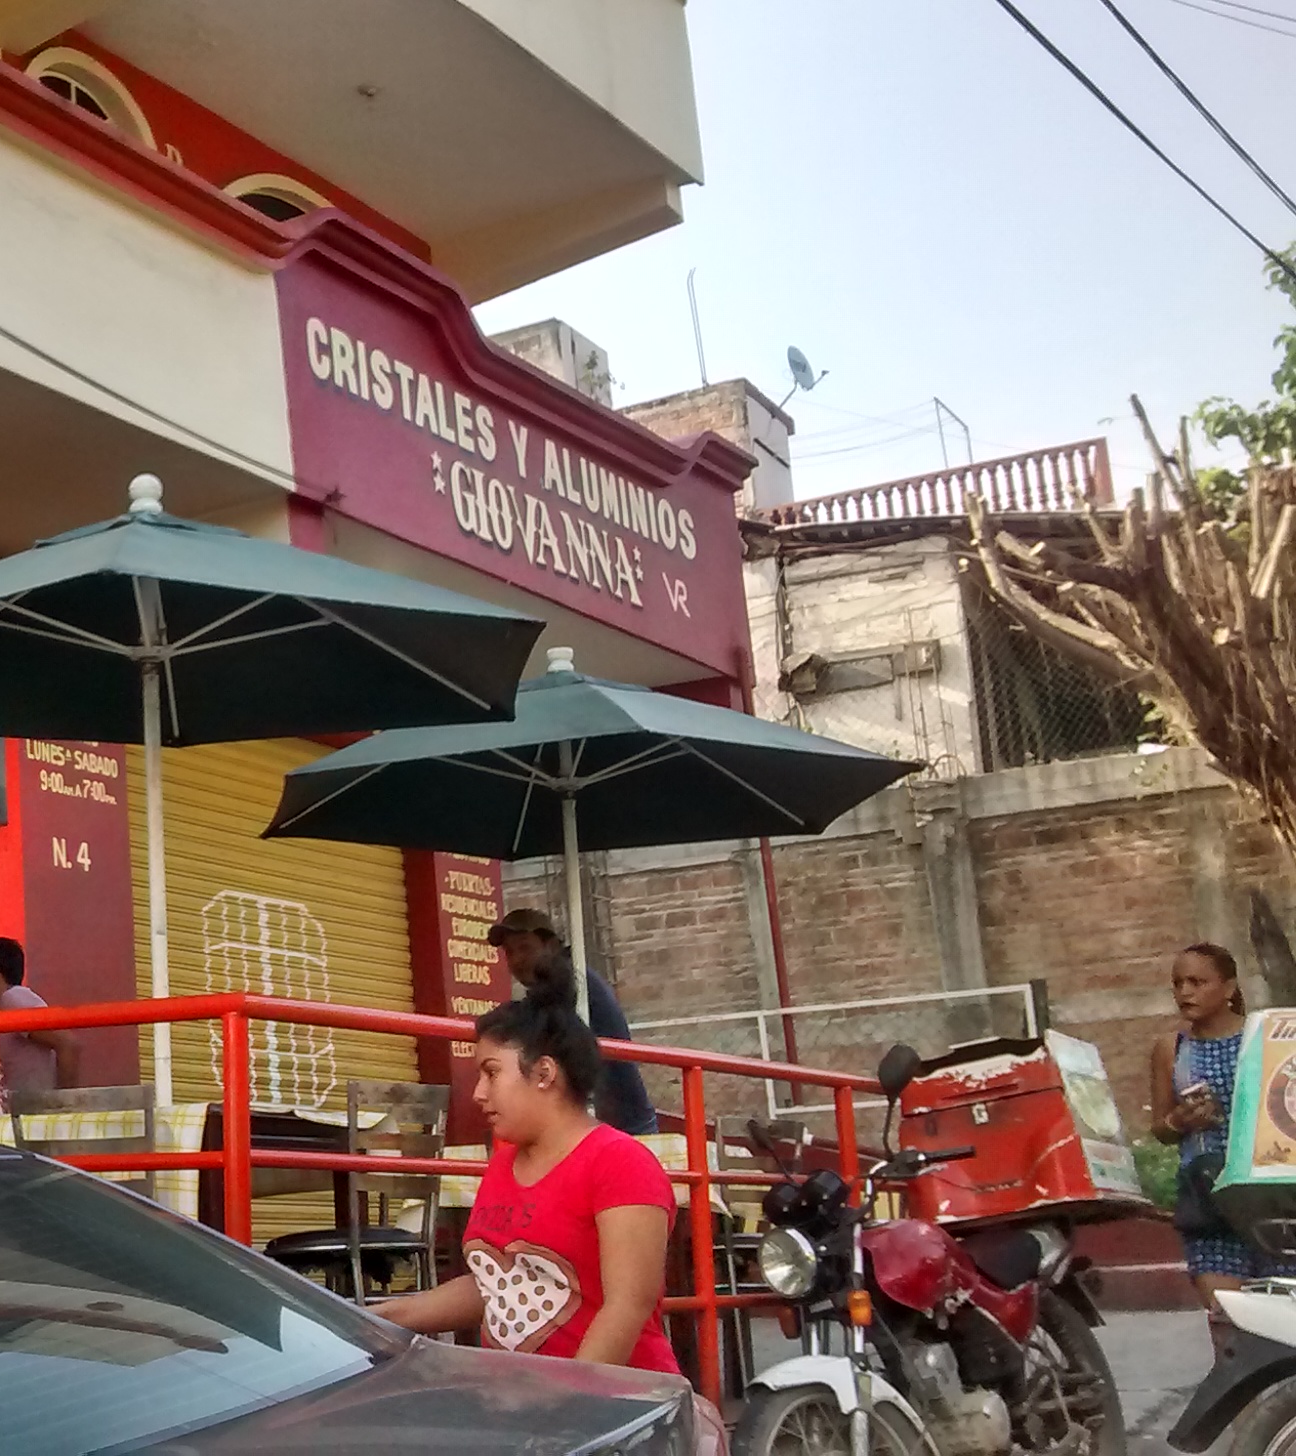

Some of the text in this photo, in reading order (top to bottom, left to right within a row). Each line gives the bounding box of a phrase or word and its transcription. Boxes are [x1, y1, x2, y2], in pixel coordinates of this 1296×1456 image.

[306, 317, 697, 560] CRISTALES Y ALUMINIOS
[451, 460, 644, 607] GIOVANNA
[26, 739, 65, 766] LUNES
[74, 750, 119, 778] SABADO
[52, 837, 92, 872] N. 4
